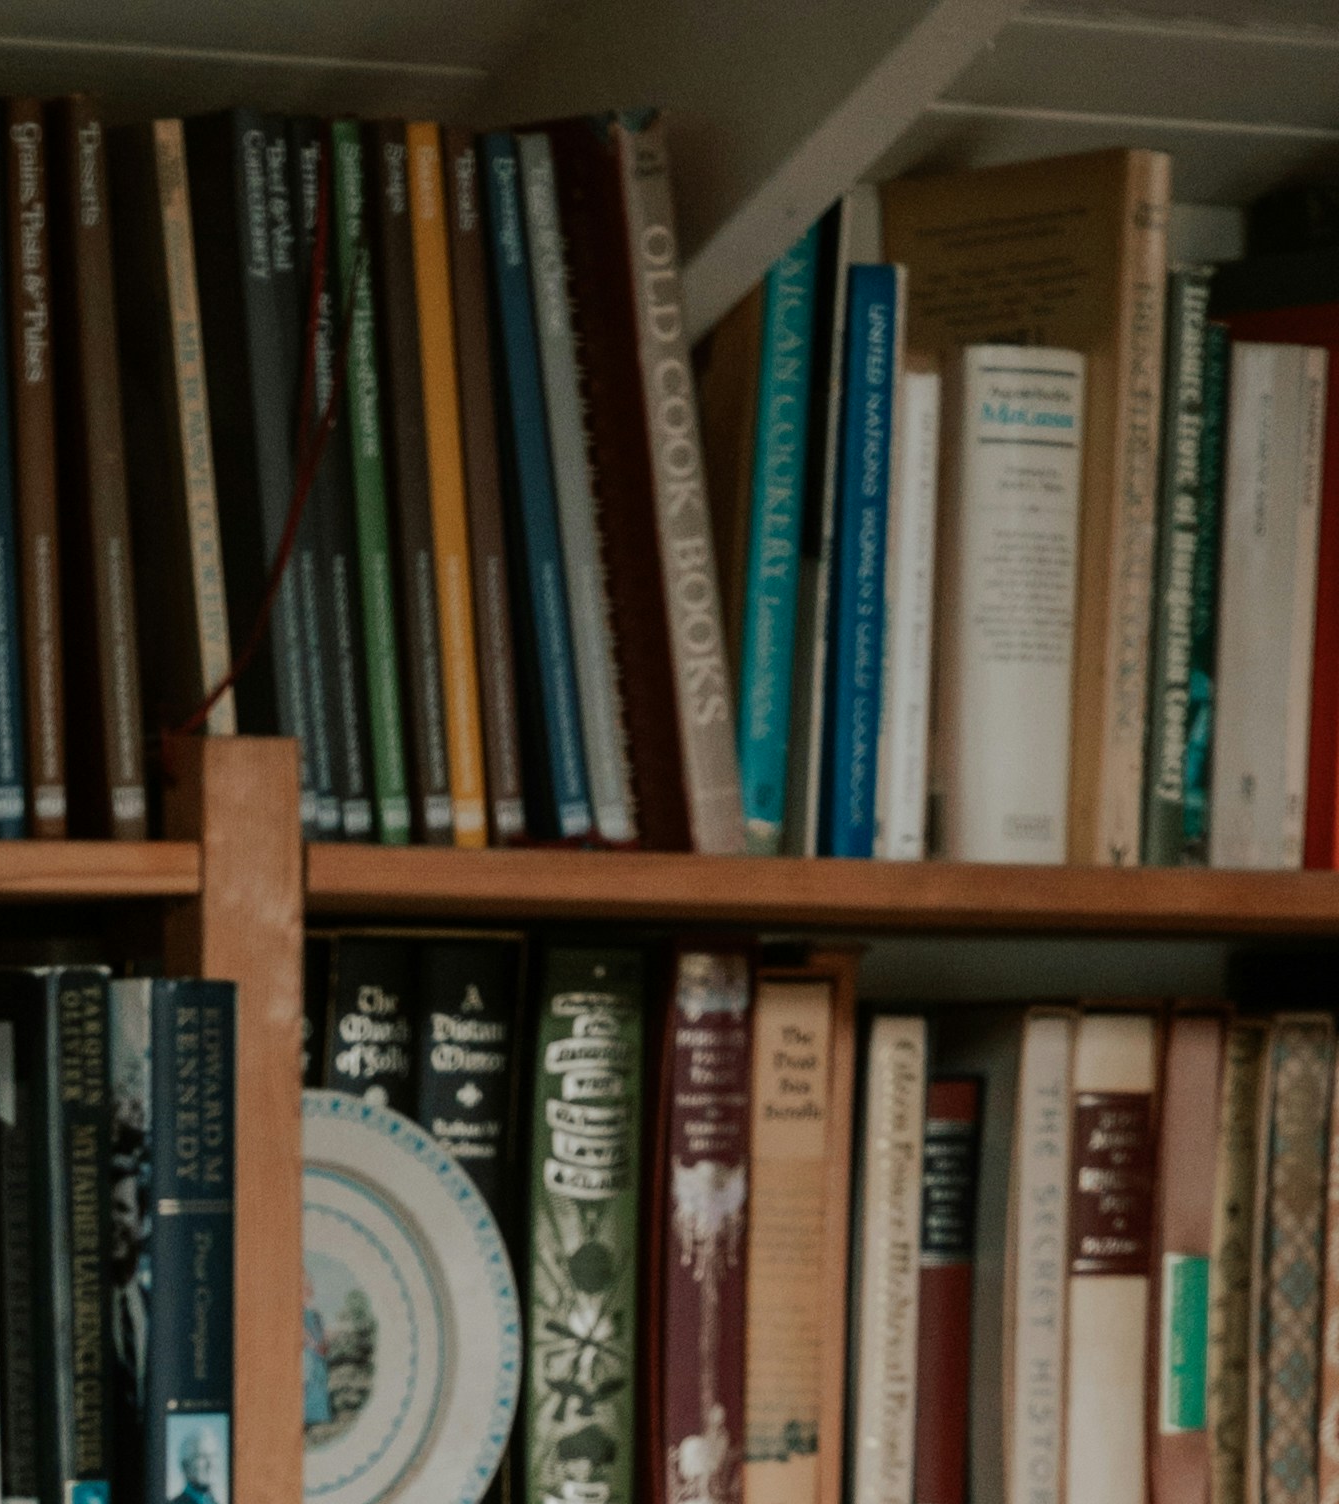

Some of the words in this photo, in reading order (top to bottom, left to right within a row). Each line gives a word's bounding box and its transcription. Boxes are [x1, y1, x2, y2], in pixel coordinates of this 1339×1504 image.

[639, 225, 681, 342] OLD
[1178, 284, 1208, 403] Treasure
[653, 357, 700, 517] COOK
[760, 395, 804, 580] COOKERY
[670, 533, 726, 726] BOOKS
[1166, 530, 1196, 682] Hungarian
[1157, 689, 1189, 801] Cookery
[61, 989, 82, 1100] OLIVIER
[82, 985, 103, 1105] TARQUIN
[174, 1006, 200, 1181] KENNEDY
[201, 1006, 223, 1147] EDWARD
[71, 1123, 100, 1158] MY
[1033, 1081, 1061, 1159] THE
[73, 1254, 101, 1375] LAURENCE
[1030, 1182, 1060, 1329] SECRET
[75, 1379, 101, 1472] OLIVIER
